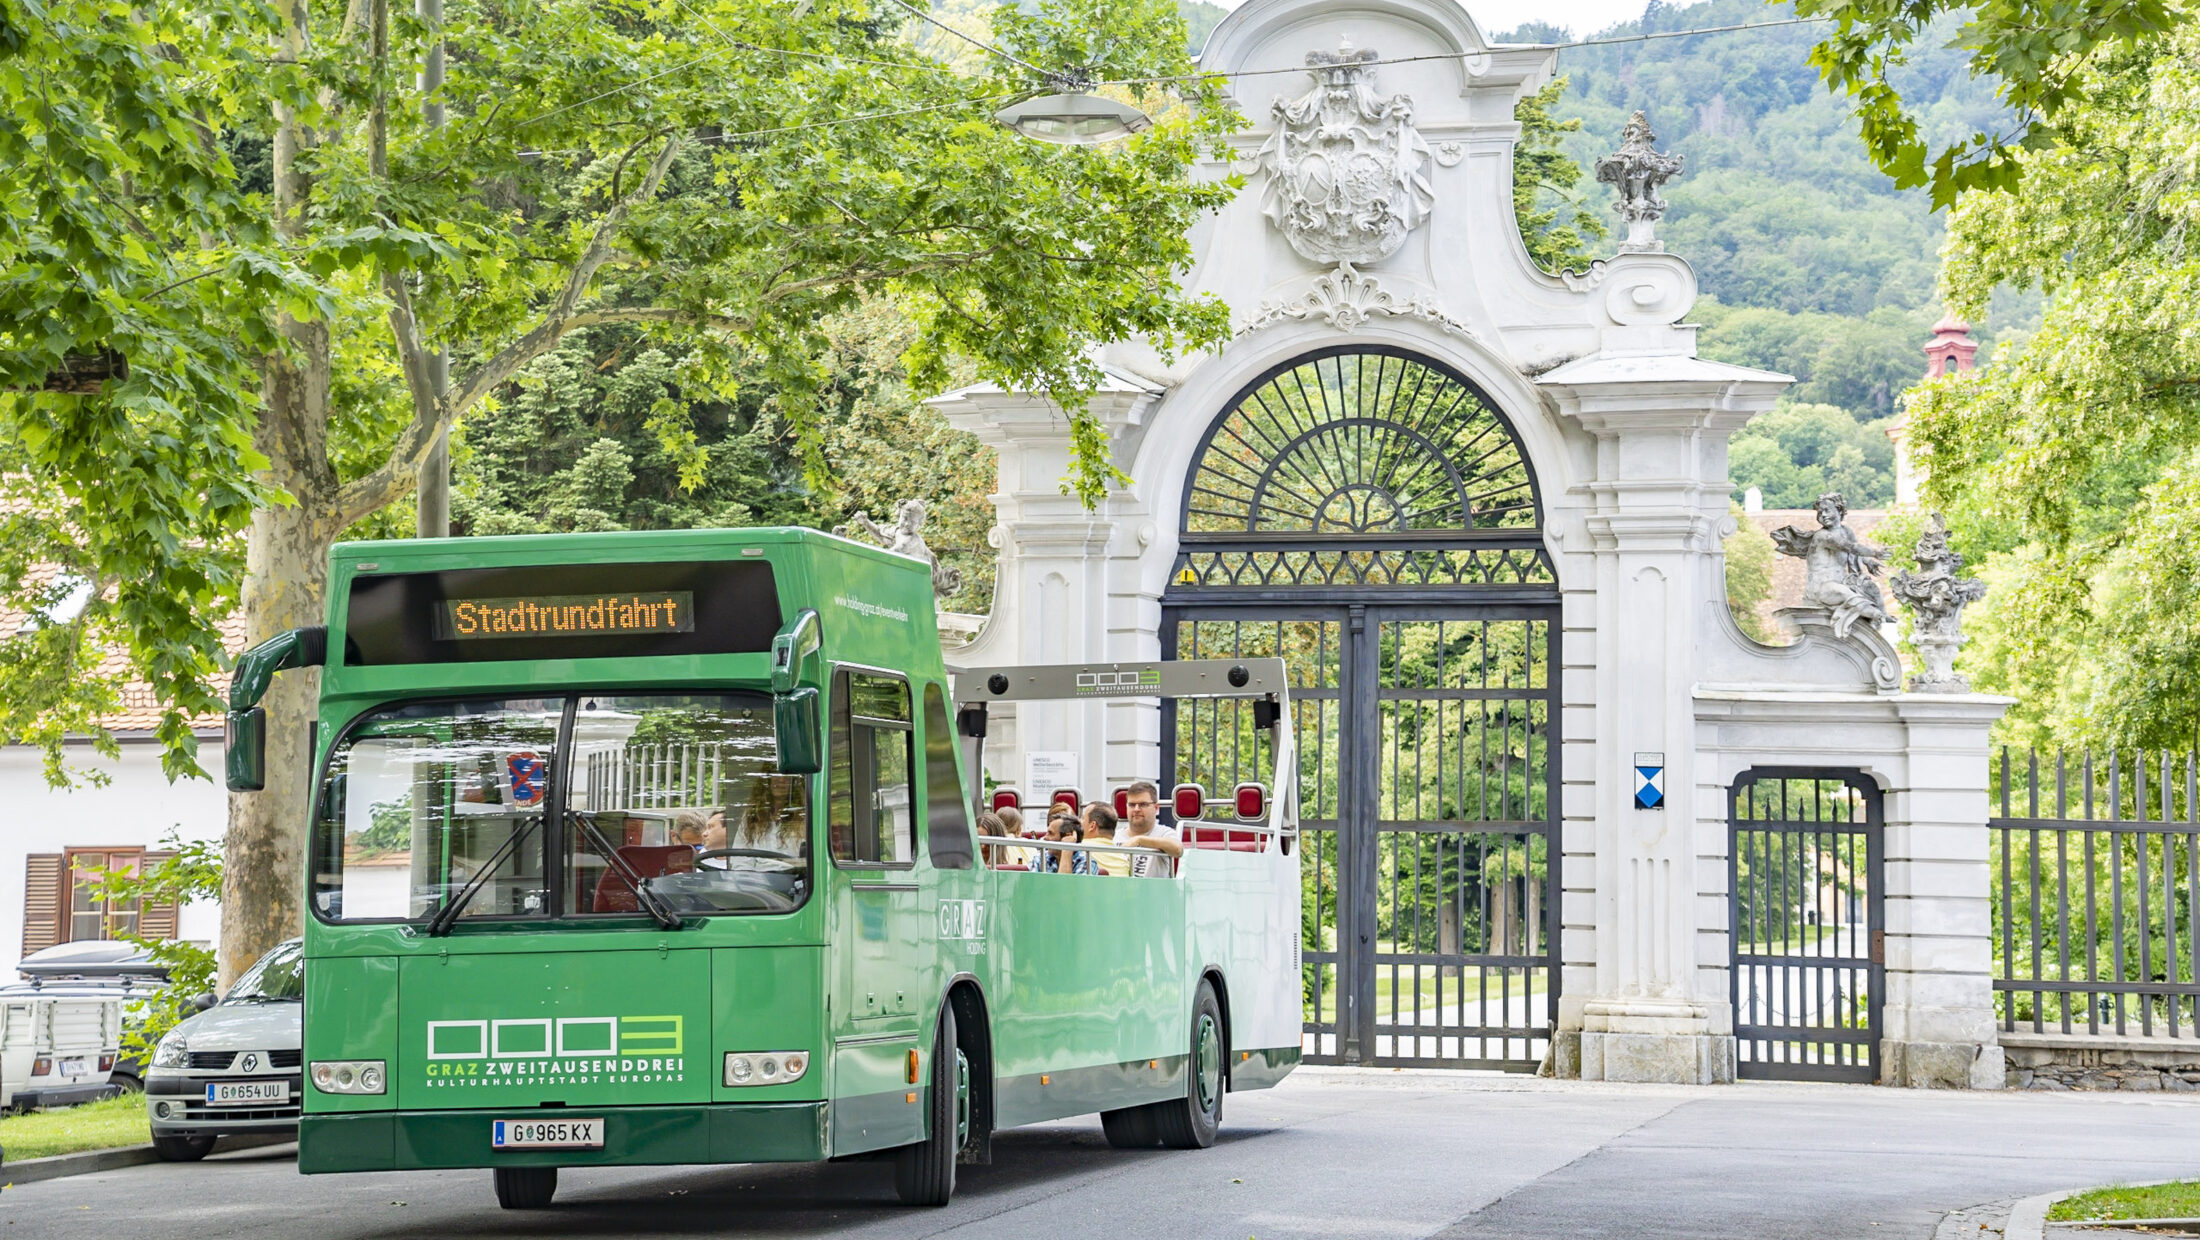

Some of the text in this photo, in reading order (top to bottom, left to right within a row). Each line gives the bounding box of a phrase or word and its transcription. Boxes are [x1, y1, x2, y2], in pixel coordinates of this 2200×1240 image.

[456, 597, 677, 634] Stadtrundfahrt
[940, 904, 984, 936] GRAZ
[426, 1058, 684, 1076] GRAZ ZWEITAUSENDDREI
[426, 1074, 684, 1087] KULTURHAUPTSTADT EUROPAS
[221, 1084, 280, 1099] G 654 UU
[514, 1124, 523, 1142] G
[536, 1124, 567, 1142] 965
[571, 1123, 592, 1141] KX
